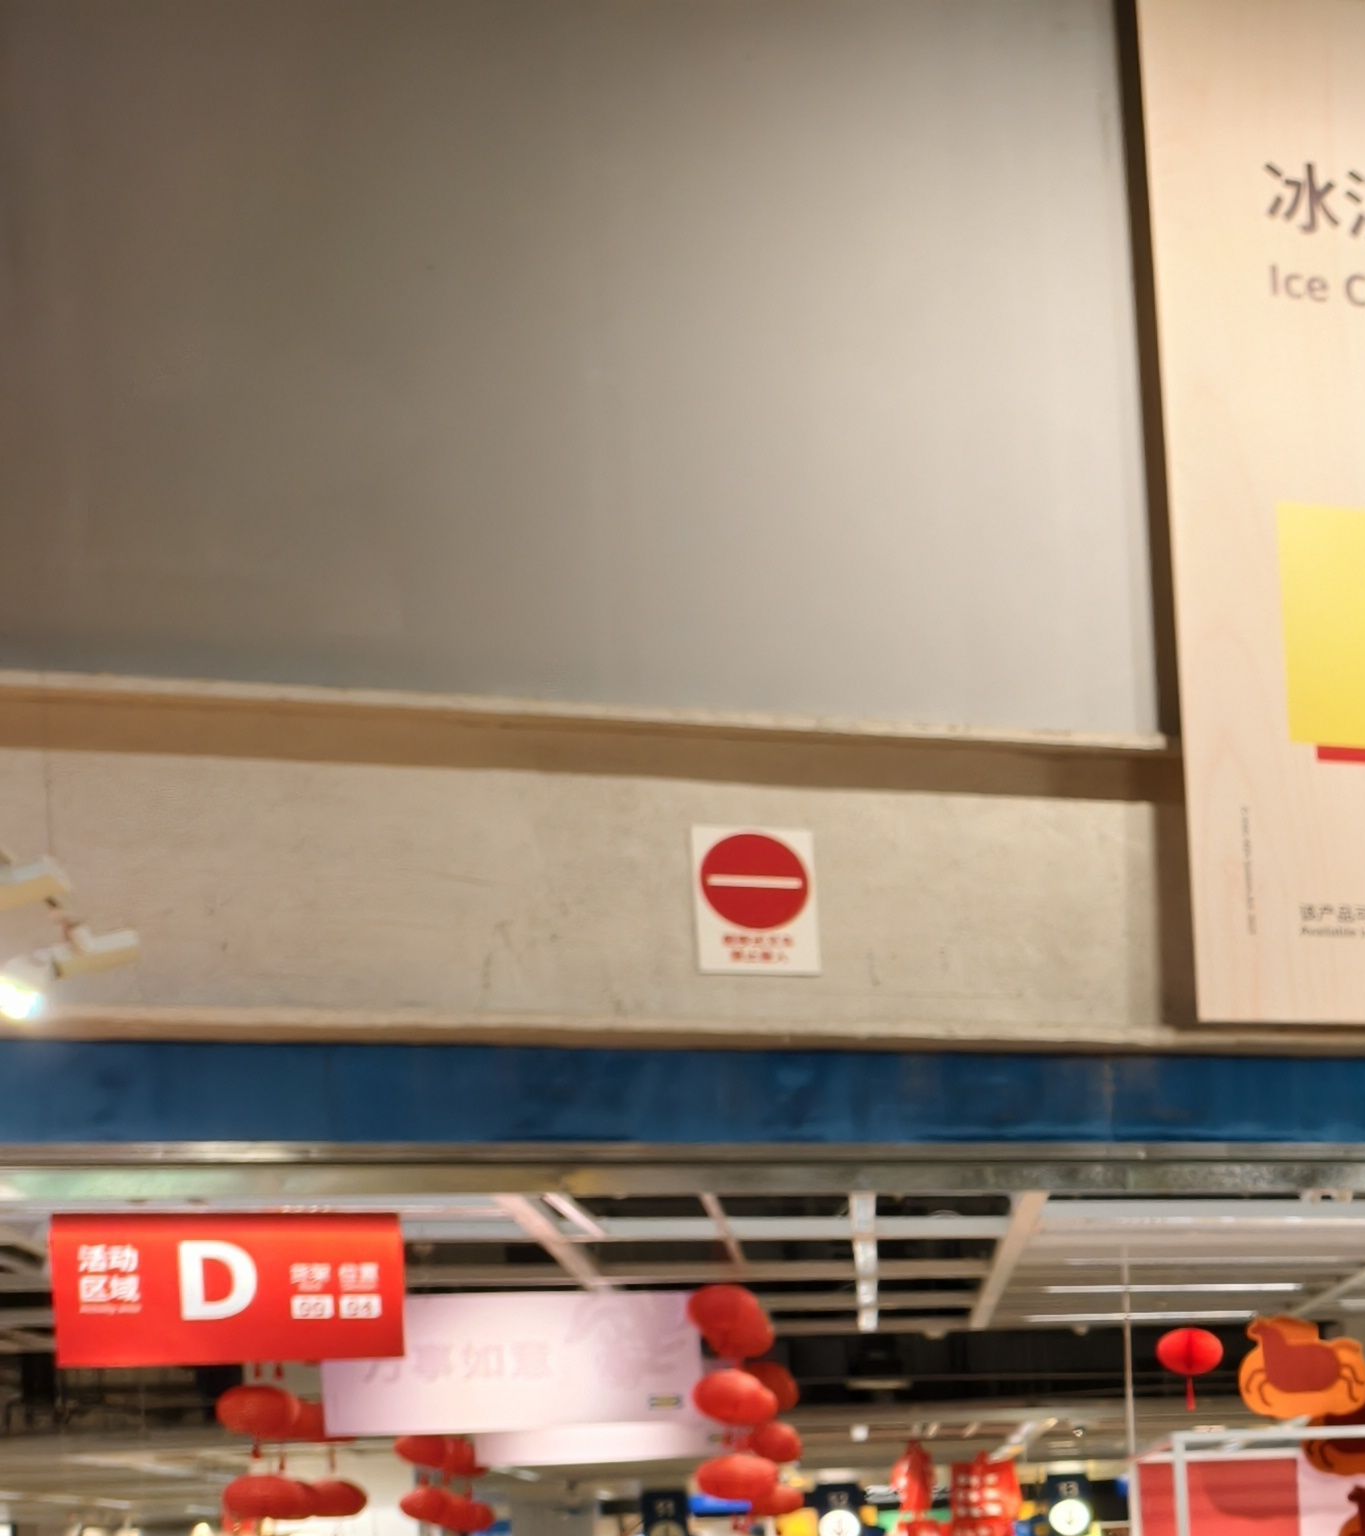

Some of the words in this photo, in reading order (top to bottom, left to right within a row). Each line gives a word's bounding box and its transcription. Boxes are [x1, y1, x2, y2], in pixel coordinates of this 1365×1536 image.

[1269, 265, 1329, 301] Ice
[78, 1244, 140, 1273] 活动
[79, 1275, 141, 1304] 区域
[177, 1239, 258, 1322] D
